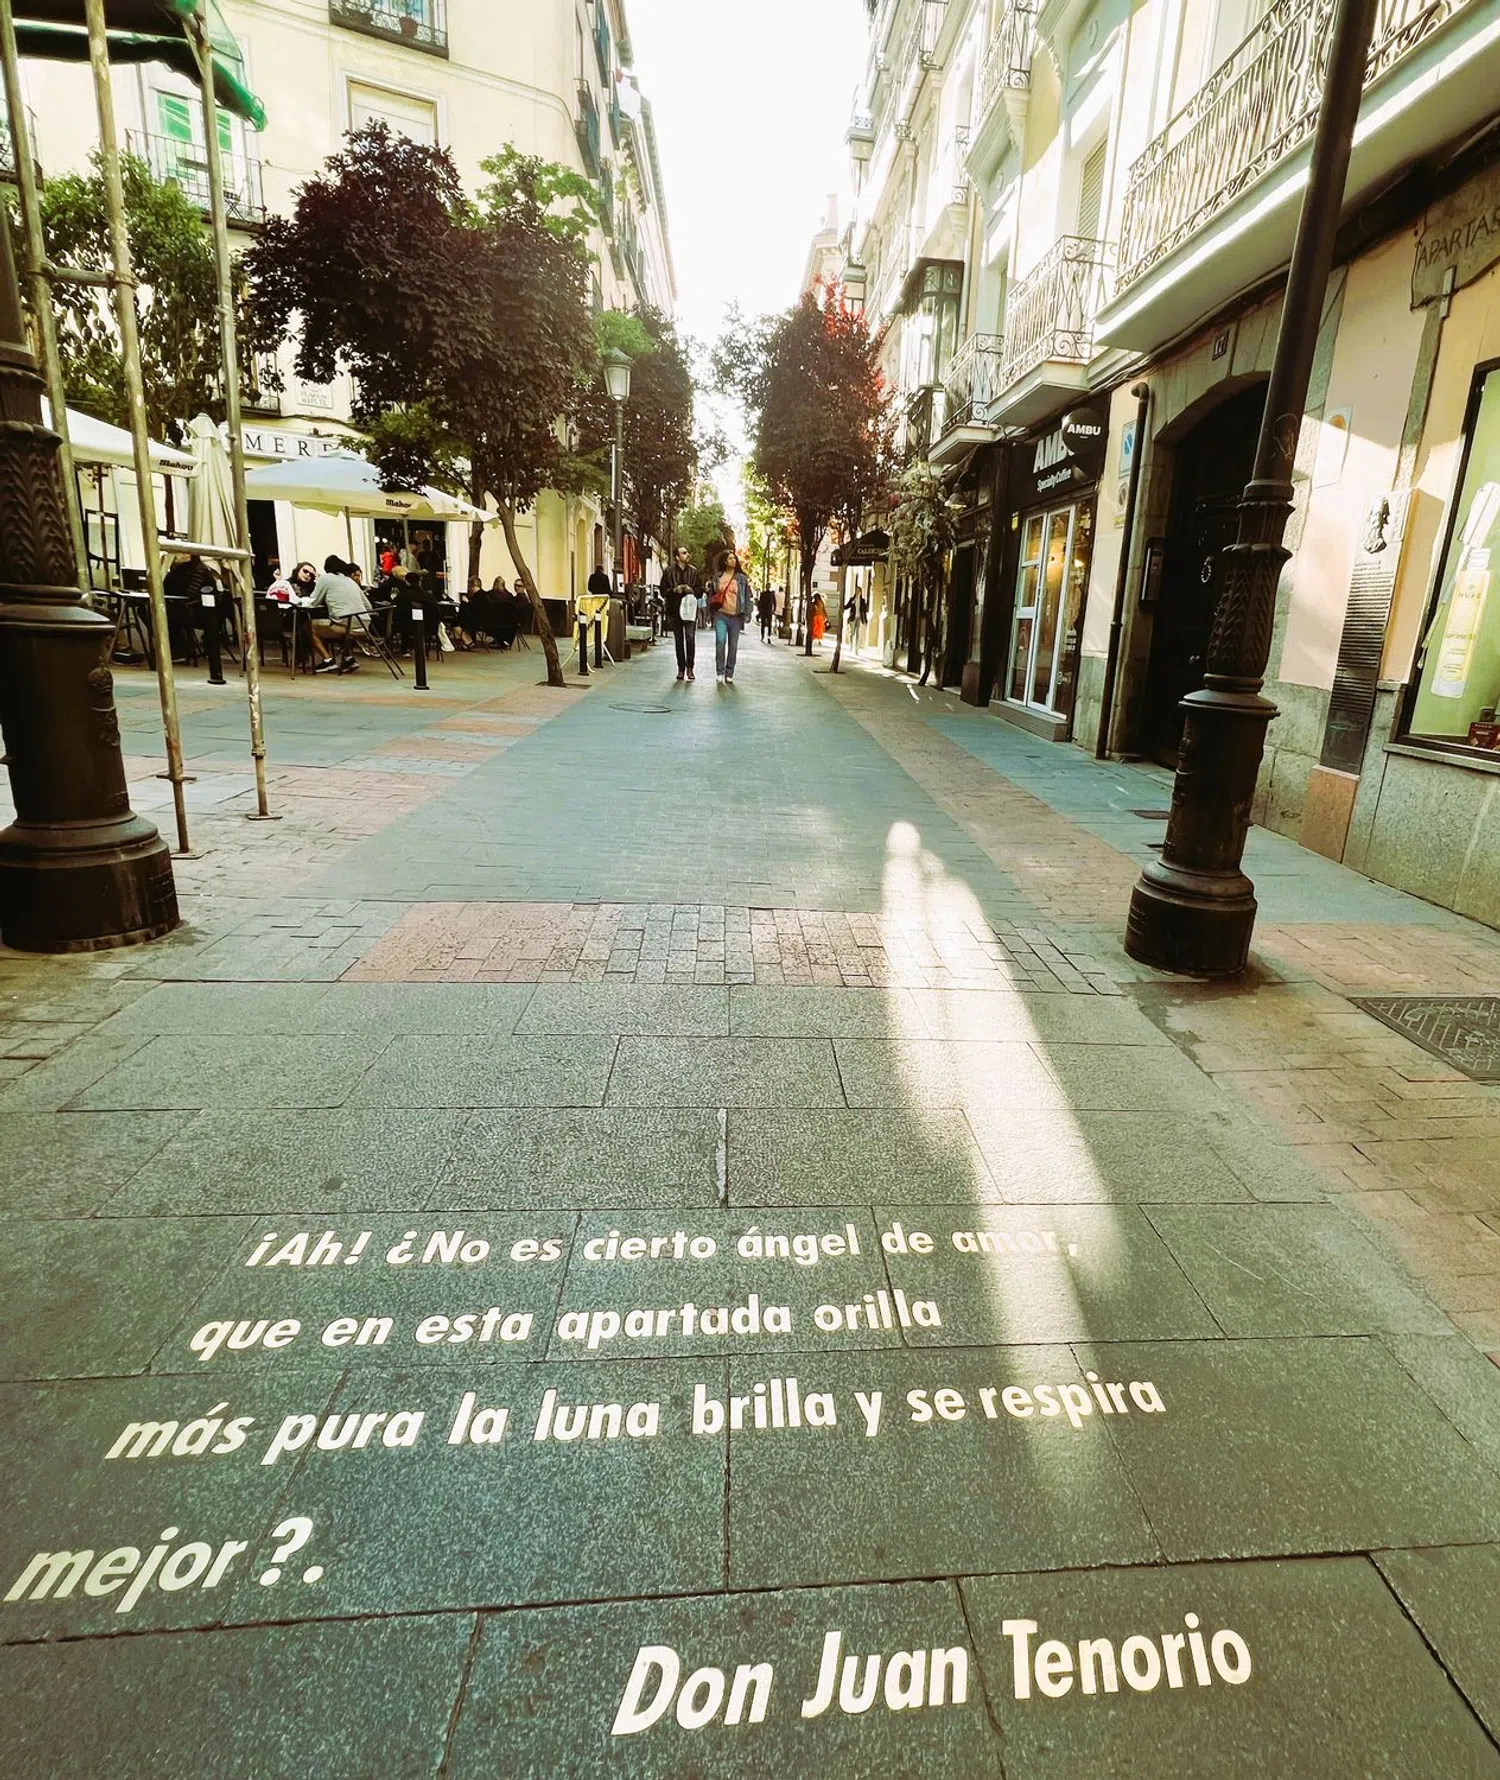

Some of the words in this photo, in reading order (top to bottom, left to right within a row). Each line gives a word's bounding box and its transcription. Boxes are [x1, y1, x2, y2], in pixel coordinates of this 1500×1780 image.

[1033, 426, 1076, 474] AMB
[1066, 423, 1102, 436] AMBU
[244, 1230, 374, 1268] ¡Ah!
[385, 1229, 491, 1265] ¿No
[509, 1237, 563, 1264] es
[582, 1227, 718, 1264] cierto
[736, 1223, 861, 1266] ángel
[881, 1221, 934, 1254] de
[951, 1224, 1079, 1257] amor,
[190, 1318, 302, 1361] que
[321, 1317, 394, 1347] en
[415, 1306, 534, 1345] esta
[557, 1293, 792, 1350] apartada
[813, 1288, 942, 1332] orilla
[105, 1402, 248, 1459] más
[260, 1411, 426, 1466] pura
[447, 1391, 509, 1447] la
[533, 1389, 660, 1443] luna
[692, 1377, 837, 1435] brilla
[854, 1391, 883, 1437] y
[907, 1388, 966, 1422] se
[979, 1371, 1166, 1429] respira
[3, 1526, 249, 1613] mejor
[610, 1645, 774, 1736] Don
[801, 1630, 968, 1718] Juan
[1002, 1612, 1252, 1699] Tenorio
